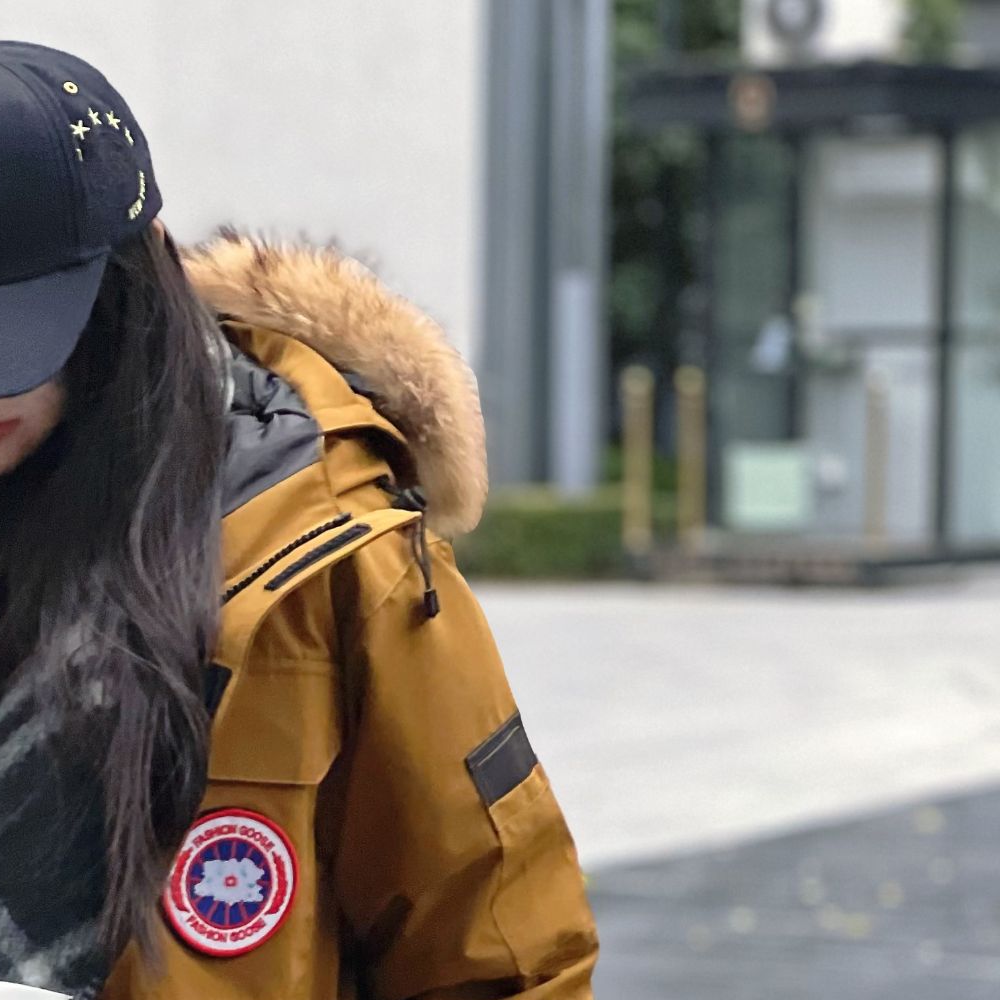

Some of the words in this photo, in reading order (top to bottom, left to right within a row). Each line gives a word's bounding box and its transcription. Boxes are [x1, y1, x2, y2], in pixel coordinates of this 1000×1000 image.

[192, 824, 237, 849] FASHION
[239, 825, 275, 852] GOOSE
[186, 915, 228, 942] FASHION
[230, 917, 266, 942] GOOSE
